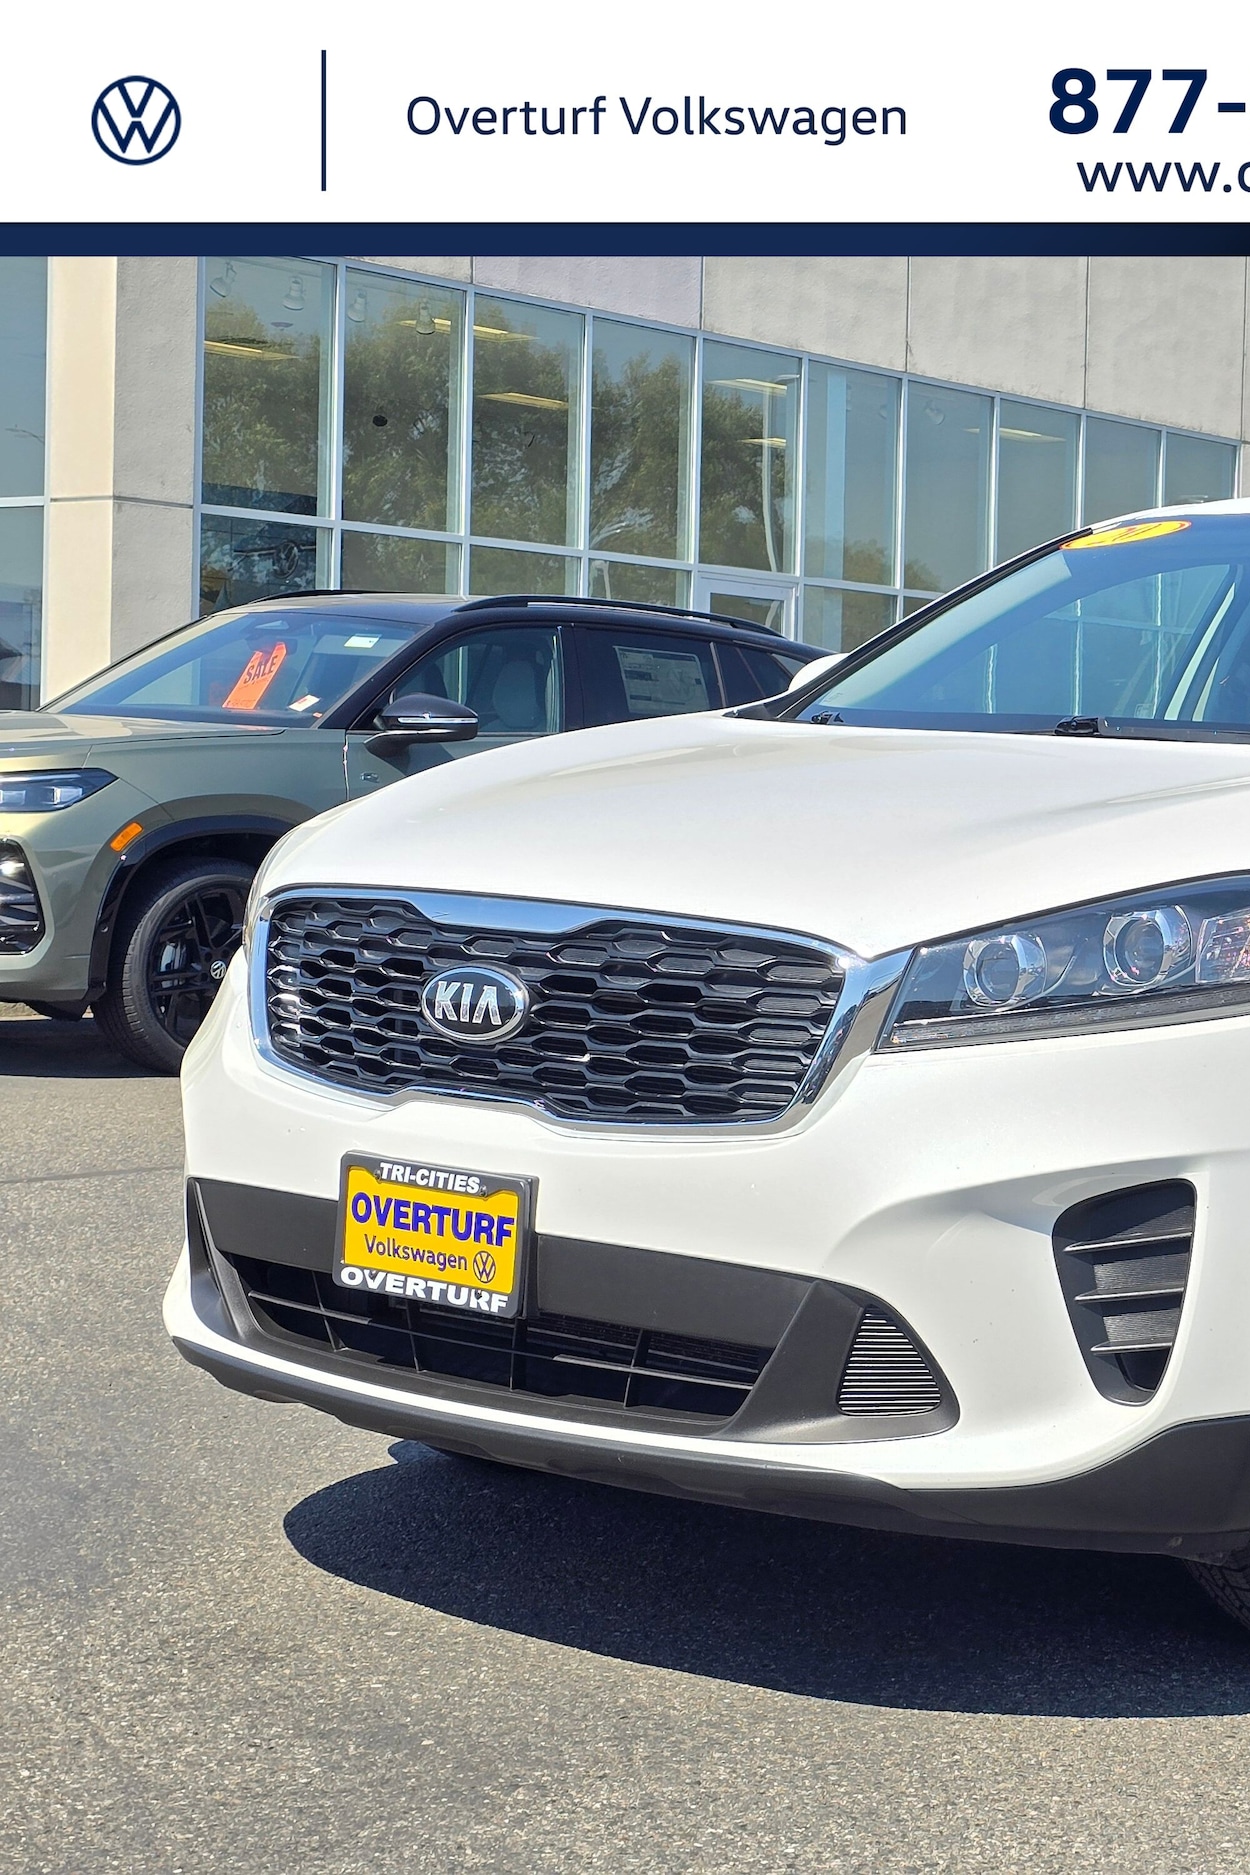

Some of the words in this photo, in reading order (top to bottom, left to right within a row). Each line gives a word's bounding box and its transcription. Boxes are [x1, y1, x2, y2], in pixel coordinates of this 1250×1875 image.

[243, 655, 278, 684] SALE
[434, 980, 502, 1026] KIA
[379, 1162, 481, 1196] TRI-CITIES
[351, 1191, 515, 1247] OVERTURF
[364, 1233, 468, 1272] Volkswagen
[340, 1266, 509, 1314] OVERTURF
